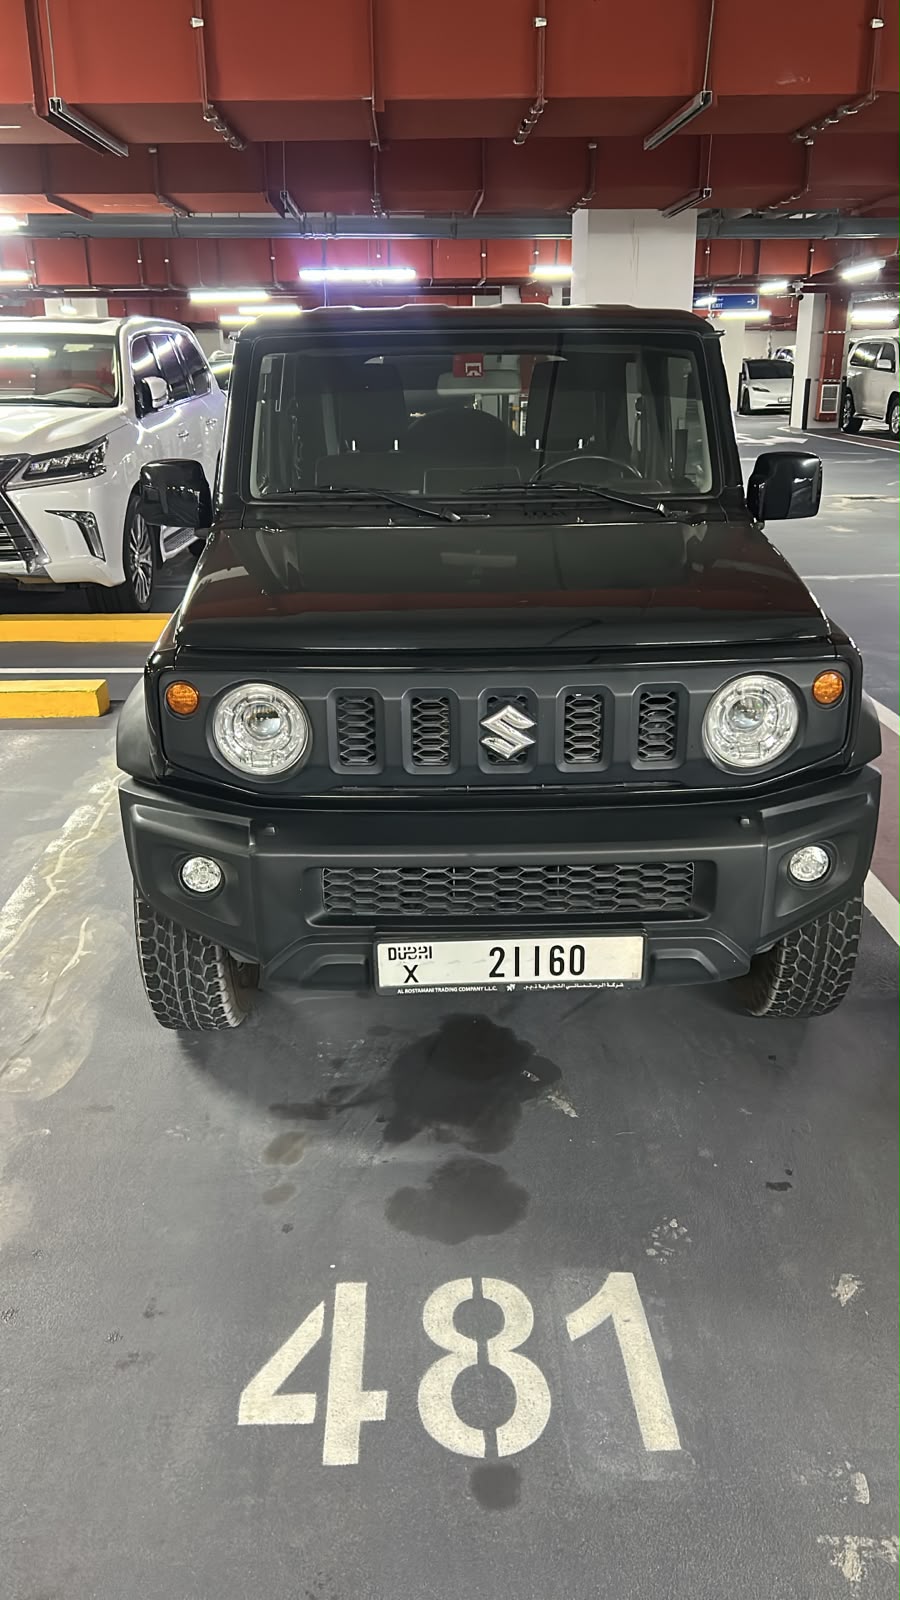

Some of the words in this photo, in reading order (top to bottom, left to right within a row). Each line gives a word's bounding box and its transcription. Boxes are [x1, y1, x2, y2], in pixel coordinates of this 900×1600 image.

[403, 964, 419, 984] X
[489, 944, 585, 978] 21160
[237, 1271, 682, 1466] 481
